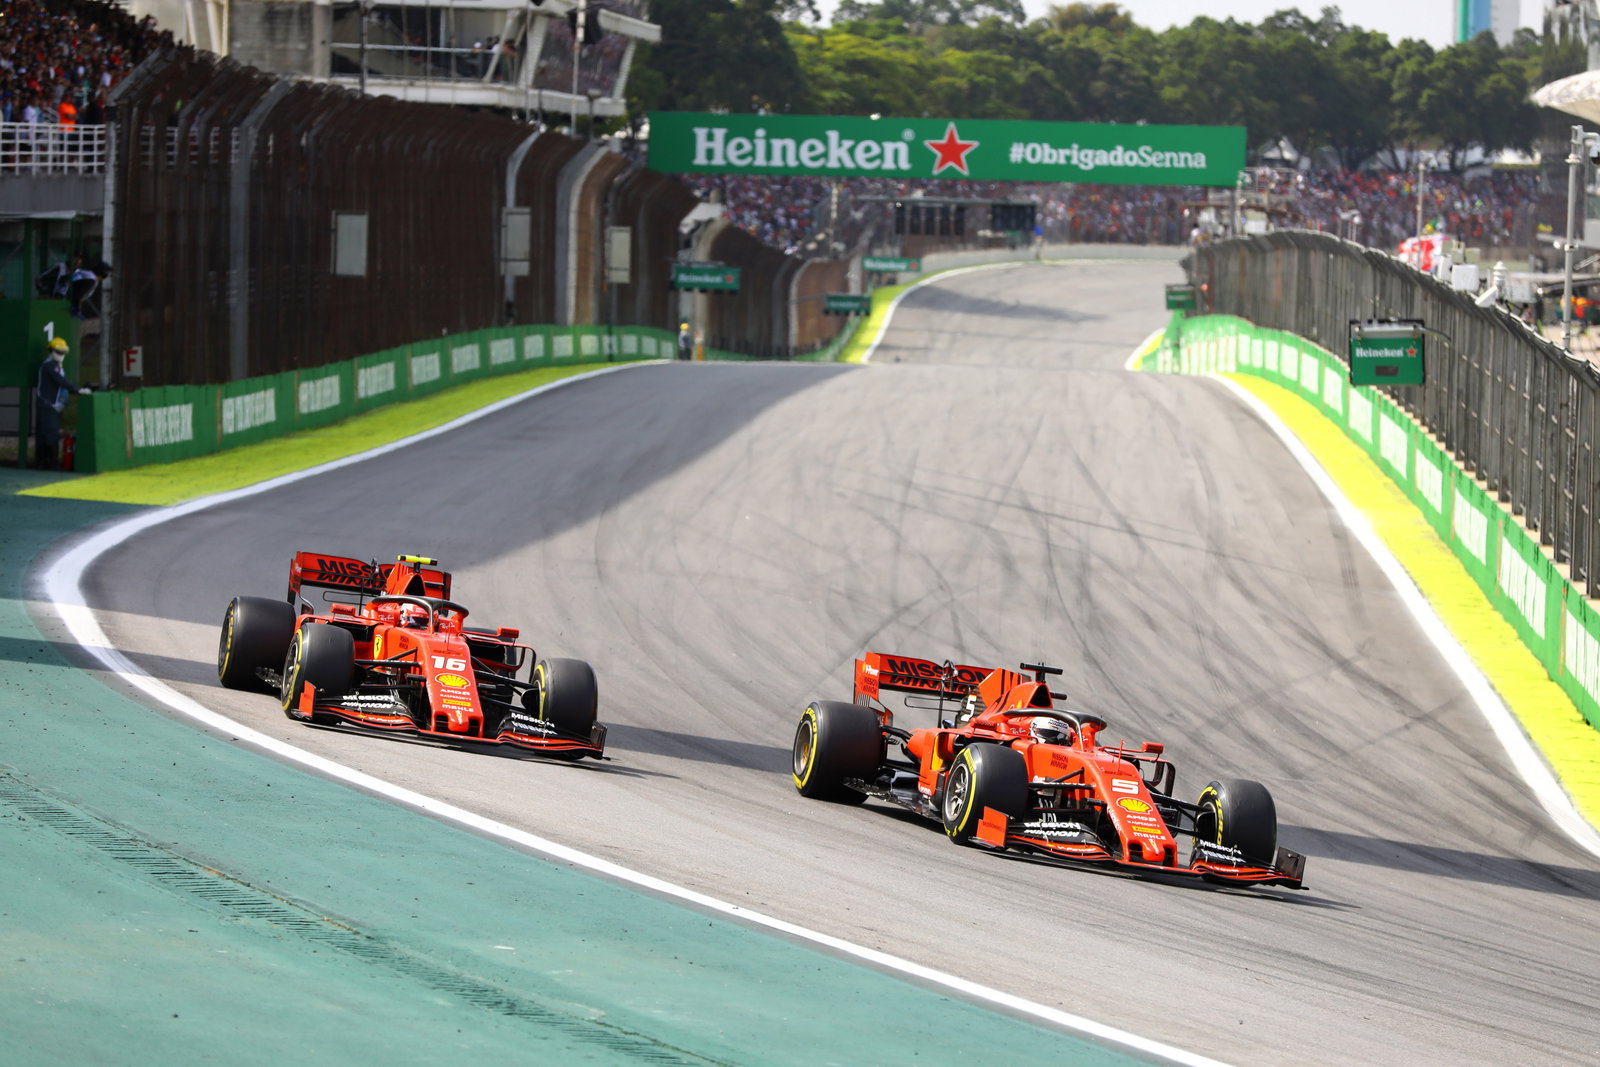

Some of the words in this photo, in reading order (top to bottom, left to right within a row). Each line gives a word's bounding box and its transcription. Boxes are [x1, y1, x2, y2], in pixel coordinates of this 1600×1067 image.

[692, 127, 912, 170] Heineken
[1009, 142, 1207, 170] #ObrigadoSenna
[43, 321, 54, 342] 1
[125, 349, 139, 372] F
[1355, 347, 1404, 358] Heineken
[431, 655, 467, 672] 16
[887, 658, 988, 683] MISSON
[960, 694, 977, 722] 5
[511, 712, 555, 728] MISSION
[1112, 778, 1139, 795] 5
